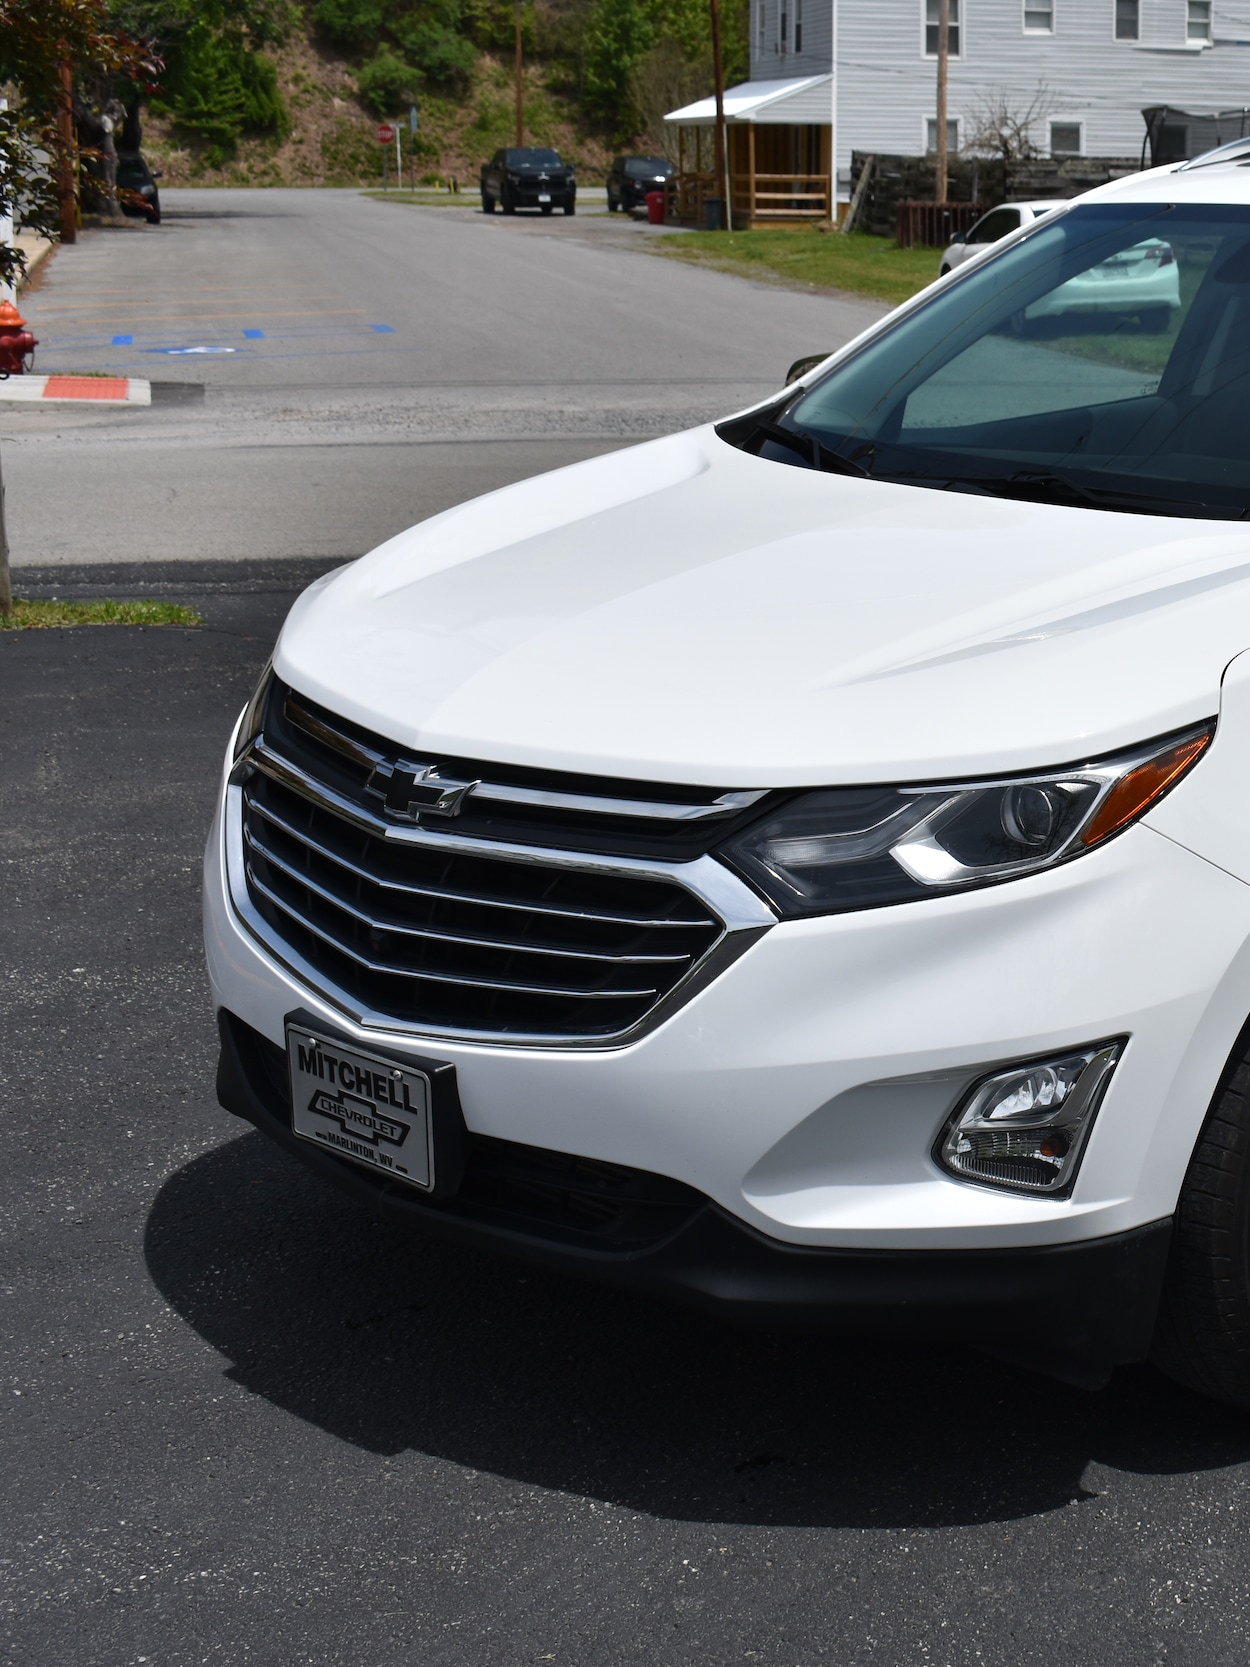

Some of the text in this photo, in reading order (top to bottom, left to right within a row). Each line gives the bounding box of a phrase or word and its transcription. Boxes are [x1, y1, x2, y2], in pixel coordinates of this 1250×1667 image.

[298, 1044, 418, 1115] MITCHELL
[320, 1098, 397, 1138] CHEVROLET
[328, 1131, 393, 1167] MARLINTON, WV
